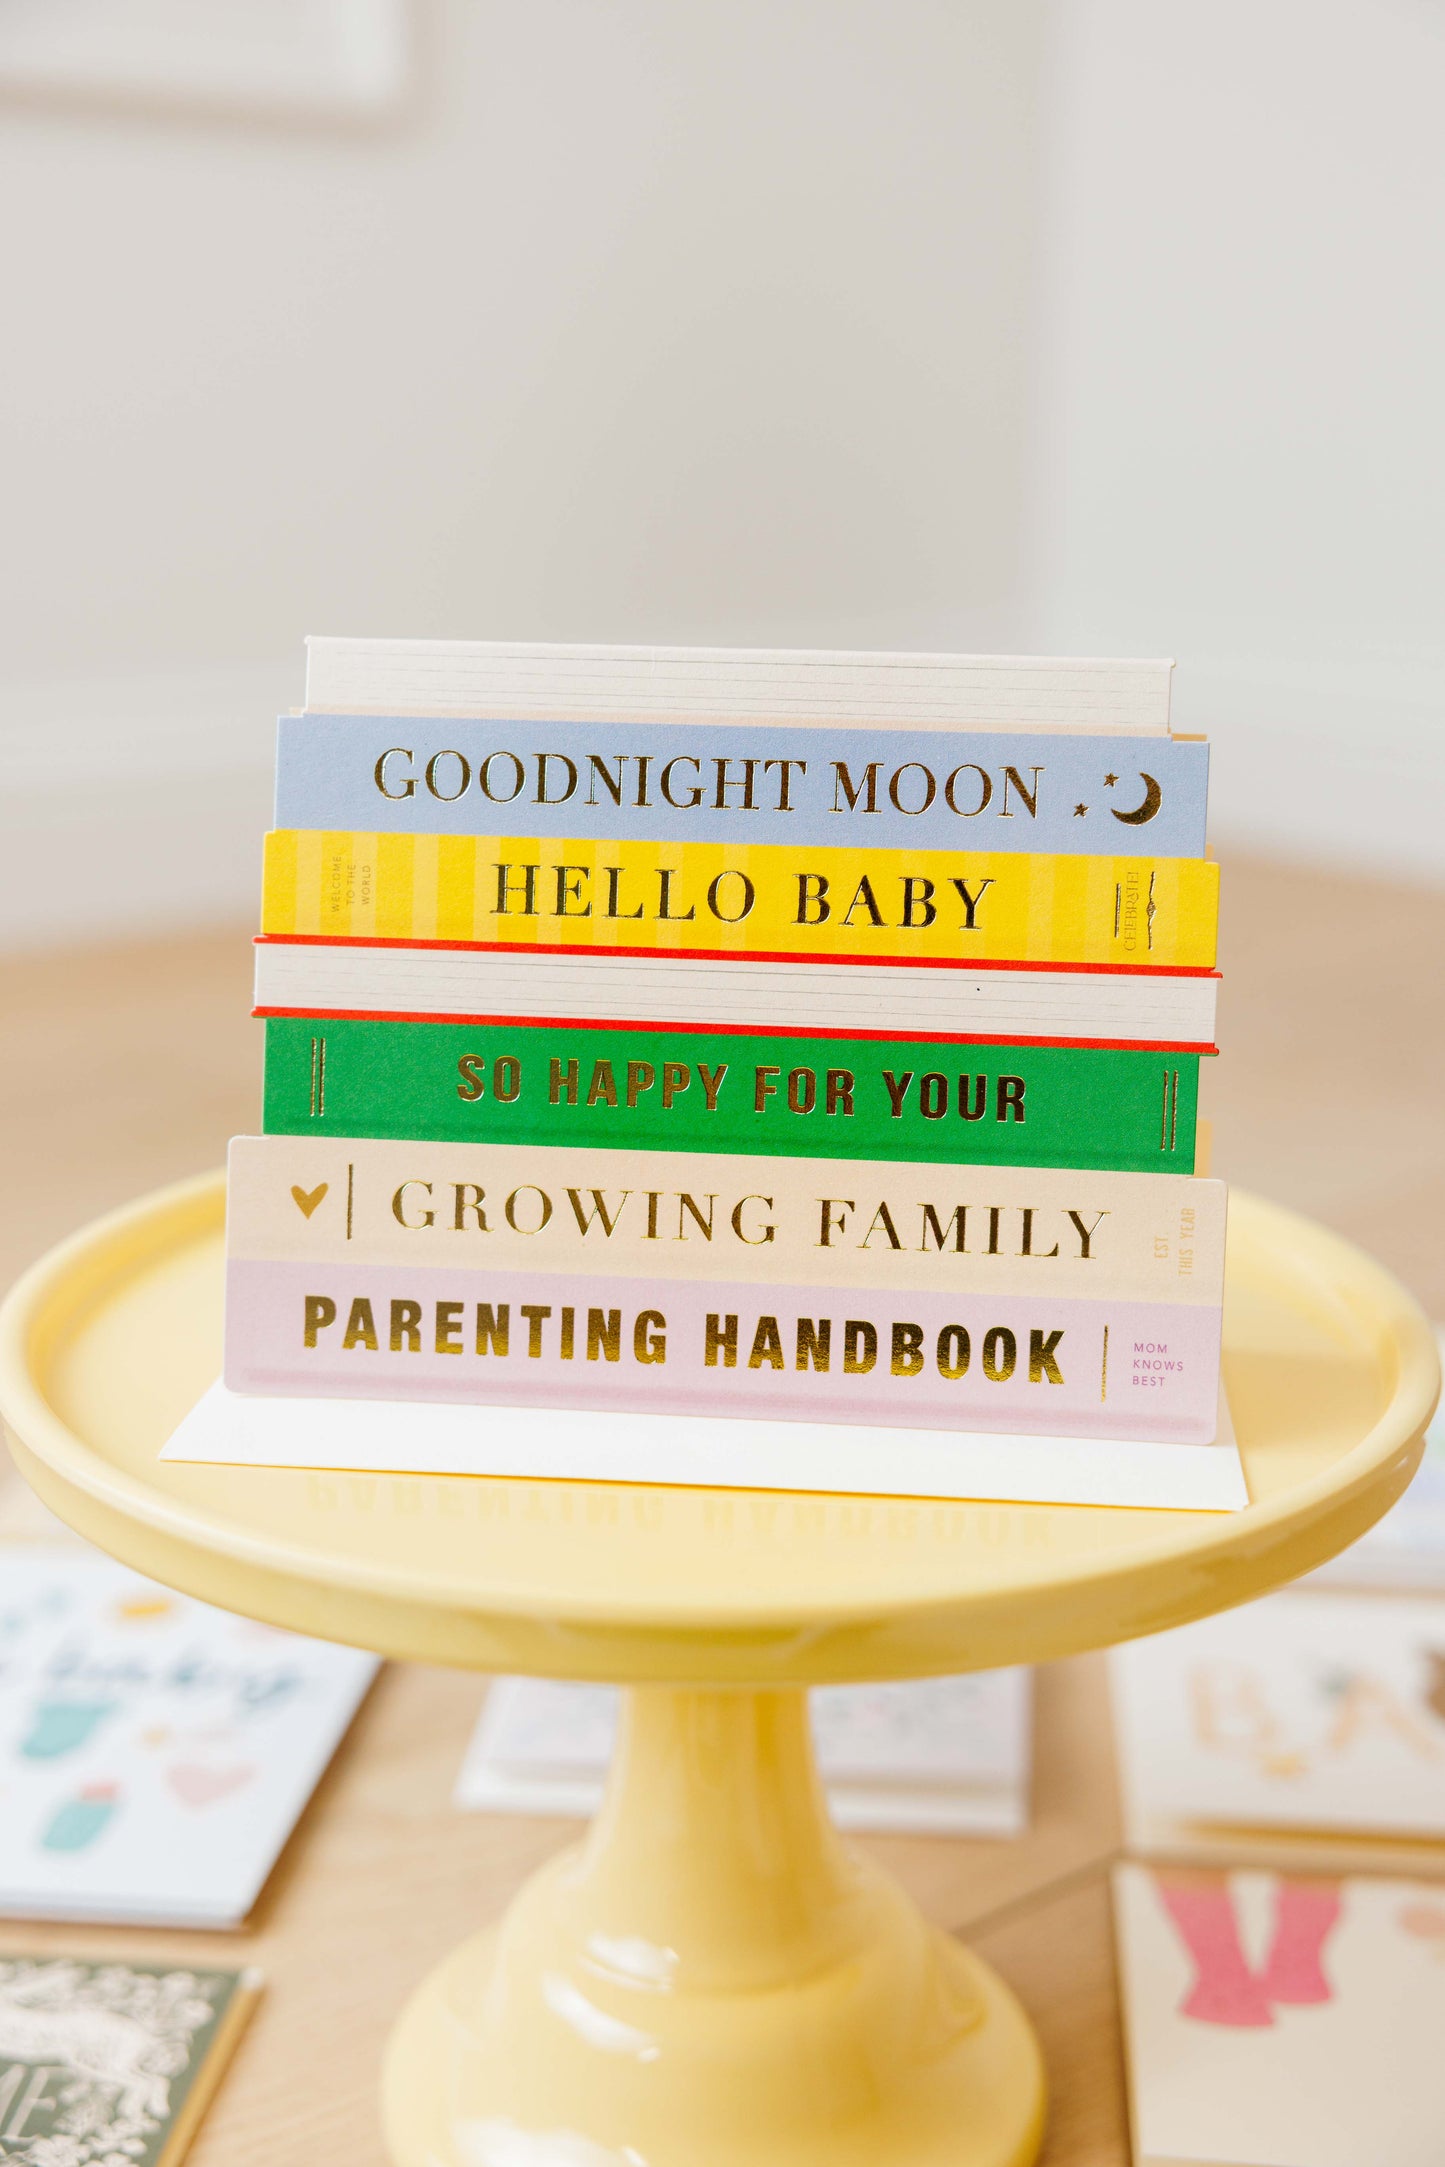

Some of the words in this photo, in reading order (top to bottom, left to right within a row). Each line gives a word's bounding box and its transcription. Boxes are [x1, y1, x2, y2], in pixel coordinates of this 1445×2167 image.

[374, 748, 807, 811] GOODNIGHT
[829, 762, 1045, 818] MOON
[331, 856, 341, 912] WELCOME
[347, 864, 356, 885] THE
[361, 865, 371, 905] WORLD
[346, 889, 355, 906] TO
[490, 864, 755, 923] HELLO
[792, 874, 996, 930] BABY
[456, 1054, 521, 1103] SO
[549, 1058, 729, 1111] HAPPY
[755, 1066, 855, 1116] FOR
[883, 1070, 1027, 1124] YOUR
[392, 1181, 778, 1245] GROWING
[815, 1198, 1111, 1259] FAMILY
[1180, 1208, 1195, 1240] YEAR
[1178, 1249, 1193, 1276] THIS
[304, 1295, 667, 1365] PARENTING
[704, 1313, 1065, 1385] HANDBOOK
[1134, 1343, 1168, 1353] MOM
[1132, 1376, 1165, 1386] BEST
[1133, 1360, 1184, 1371] KNOWS
